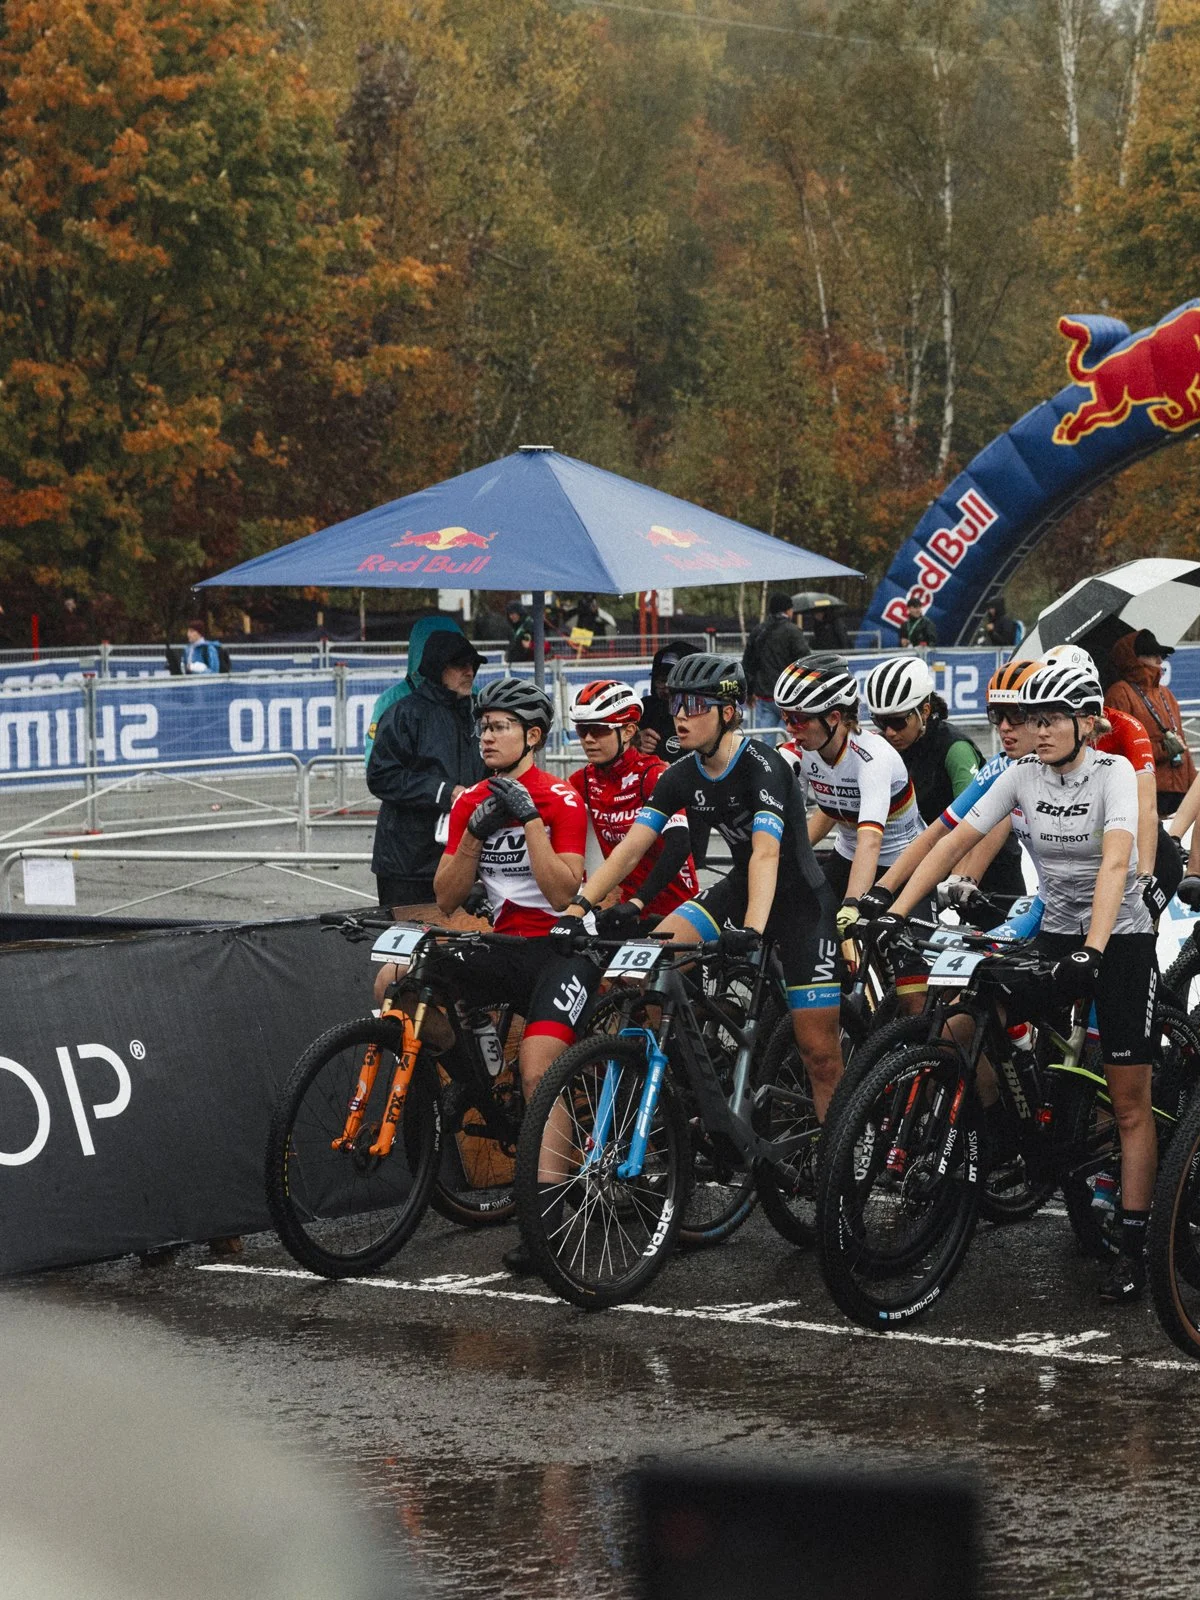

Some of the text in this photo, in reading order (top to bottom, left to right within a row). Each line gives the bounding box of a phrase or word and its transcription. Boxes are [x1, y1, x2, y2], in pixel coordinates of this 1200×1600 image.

[356, 554, 491, 575] Red Bull
[881, 550, 952, 628] Red
[926, 487, 999, 569] Bull
[1052, 833, 1090, 843] TISSOT
[480, 854, 520, 863] FACTORY
[550, 926, 572, 935] USA
[391, 933, 406, 950] 1
[619, 950, 652, 967] 18
[946, 955, 967, 972] 4
[386, 1092, 406, 1125] FOX
[938, 1127, 958, 1175] DT SWISS
[968, 1130, 978, 1183] DT SWISS
[888, 1286, 941, 1321] SCHWALBE
